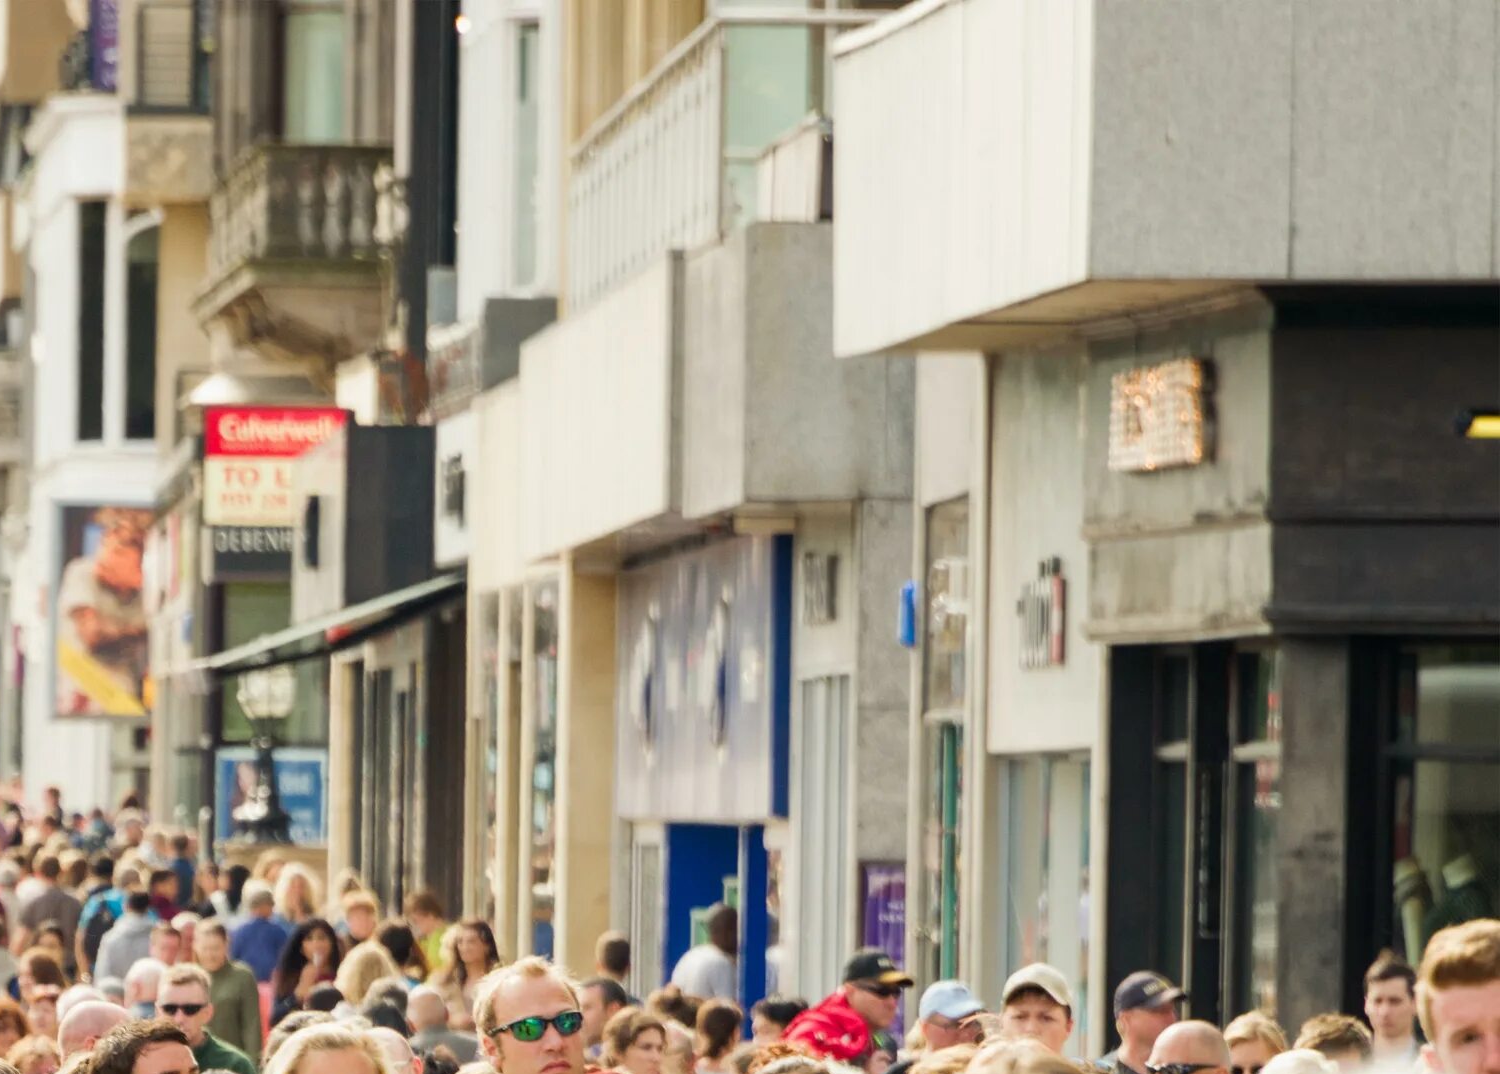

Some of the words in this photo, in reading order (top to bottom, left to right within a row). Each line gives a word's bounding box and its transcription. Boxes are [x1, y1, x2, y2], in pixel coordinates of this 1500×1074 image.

[222, 466, 259, 487] TO
[275, 466, 292, 488] L
[214, 529, 293, 552] DEBENH
